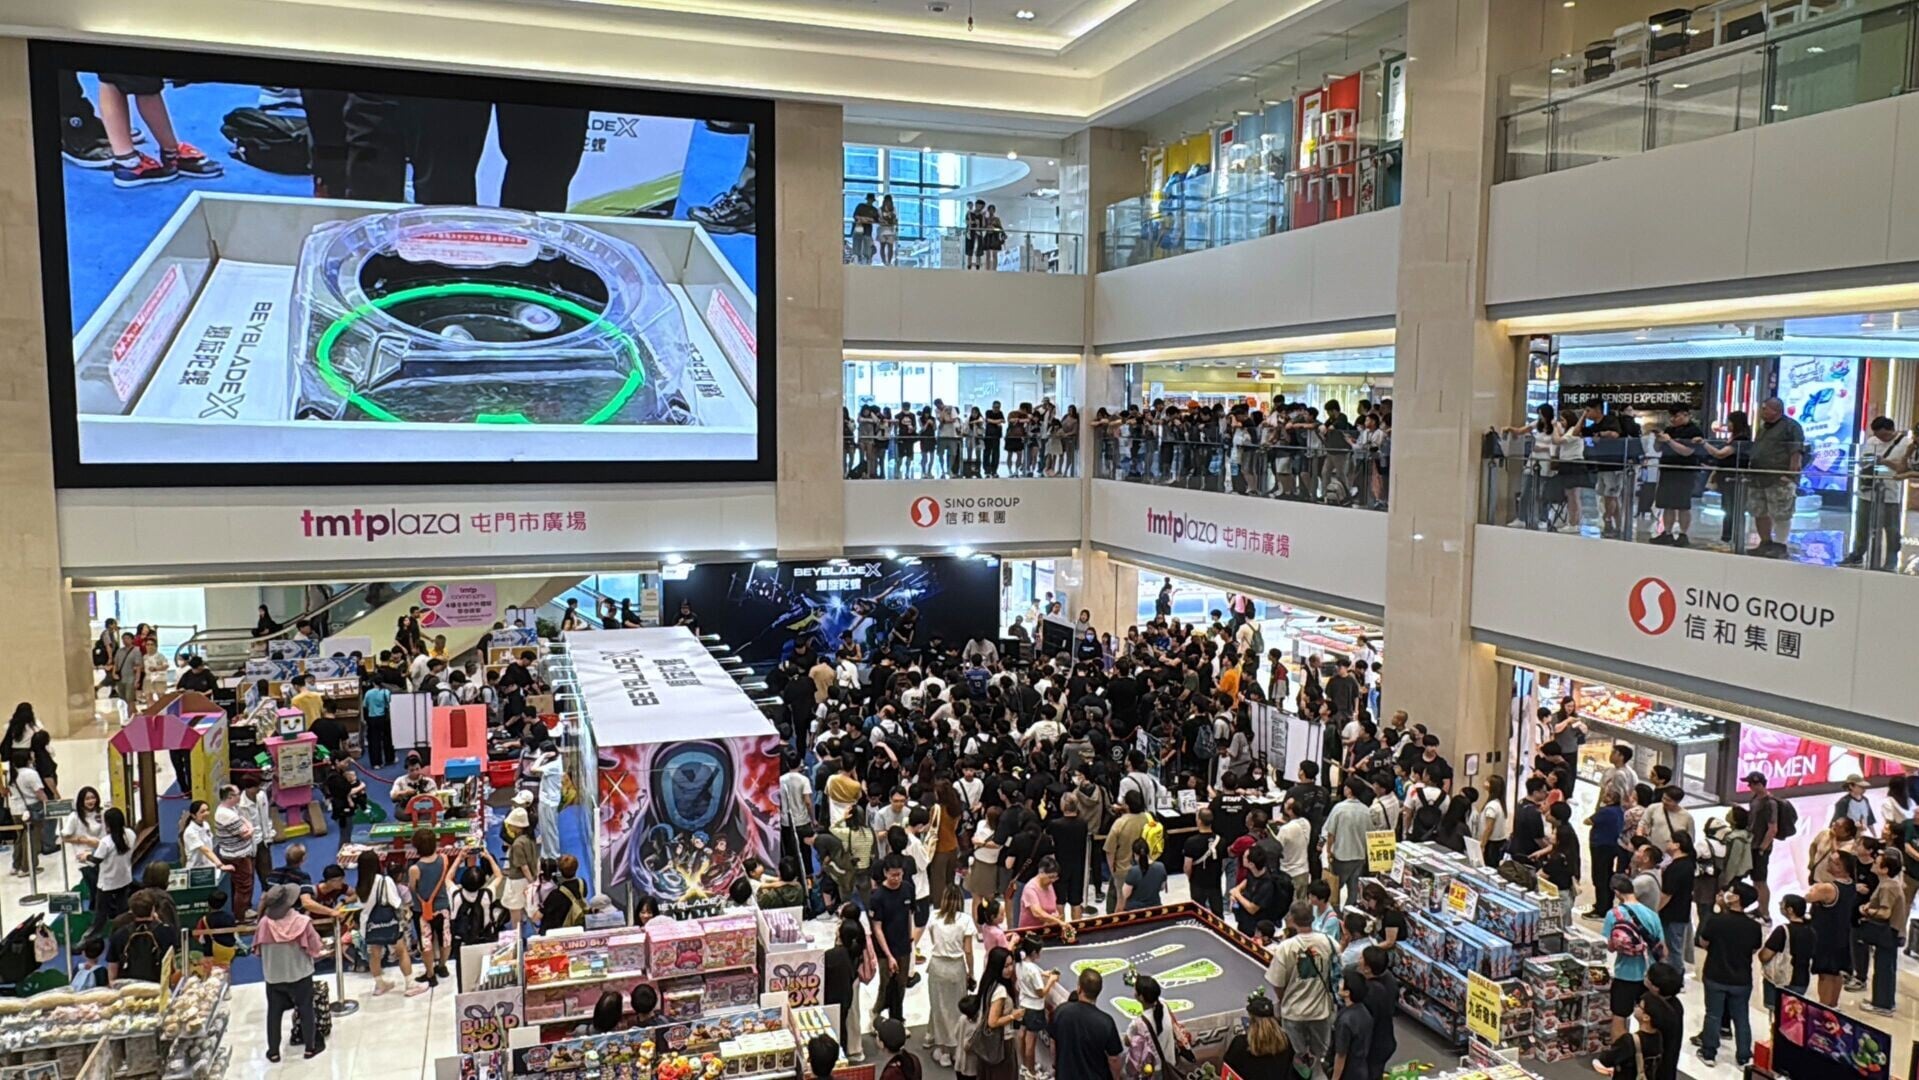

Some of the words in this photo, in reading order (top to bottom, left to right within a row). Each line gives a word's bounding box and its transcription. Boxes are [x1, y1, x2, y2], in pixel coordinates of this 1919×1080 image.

[590, 117, 640, 137] DEX
[1563, 393, 1579, 404] THE
[1633, 392, 1692, 404] EXPERIENCE
[945, 498, 975, 508] SINO
[977, 497, 1020, 508] GROUP
[301, 509, 461, 542] tmtplaza
[470, 511, 587, 532] 屯門市廣場
[945, 510, 1006, 529] 信和集團
[1147, 507, 1218, 544] tmtplaza
[1222, 526, 1290, 558] 屯門市廣場
[1685, 587, 1740, 613] SINO
[1746, 596, 1835, 628] GROUP
[1684, 613, 1801, 659] 信和集團
[1743, 754, 1817, 778] WOMEN
[787, 988, 820, 1008] OX
